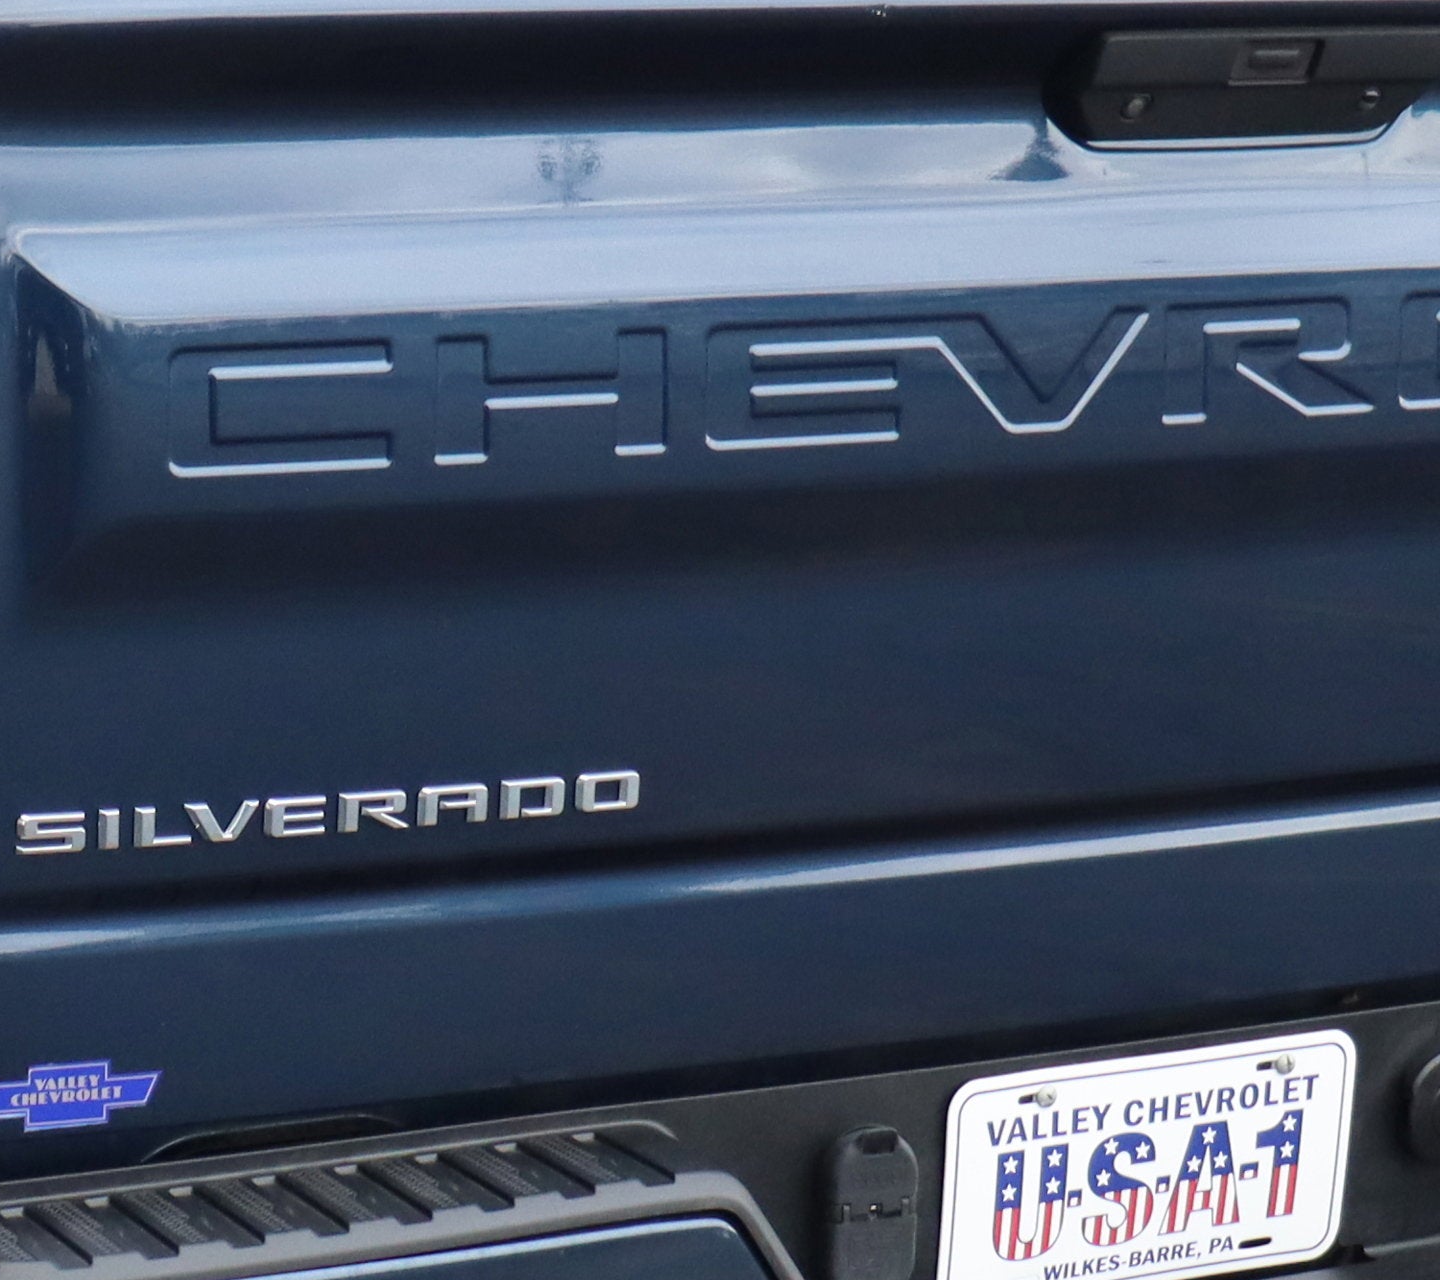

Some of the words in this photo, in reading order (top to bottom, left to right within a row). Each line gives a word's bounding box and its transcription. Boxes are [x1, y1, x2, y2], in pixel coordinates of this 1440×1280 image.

[15, 770, 641, 855] SILVERADO
[34, 1074, 101, 1092] VALLEY
[10, 1085, 124, 1108] CHEVROLET
[986, 1103, 1112, 1147] VALLEY
[1122, 1074, 1320, 1127] CHEVROLET
[1209, 1235, 1234, 1255] PA
